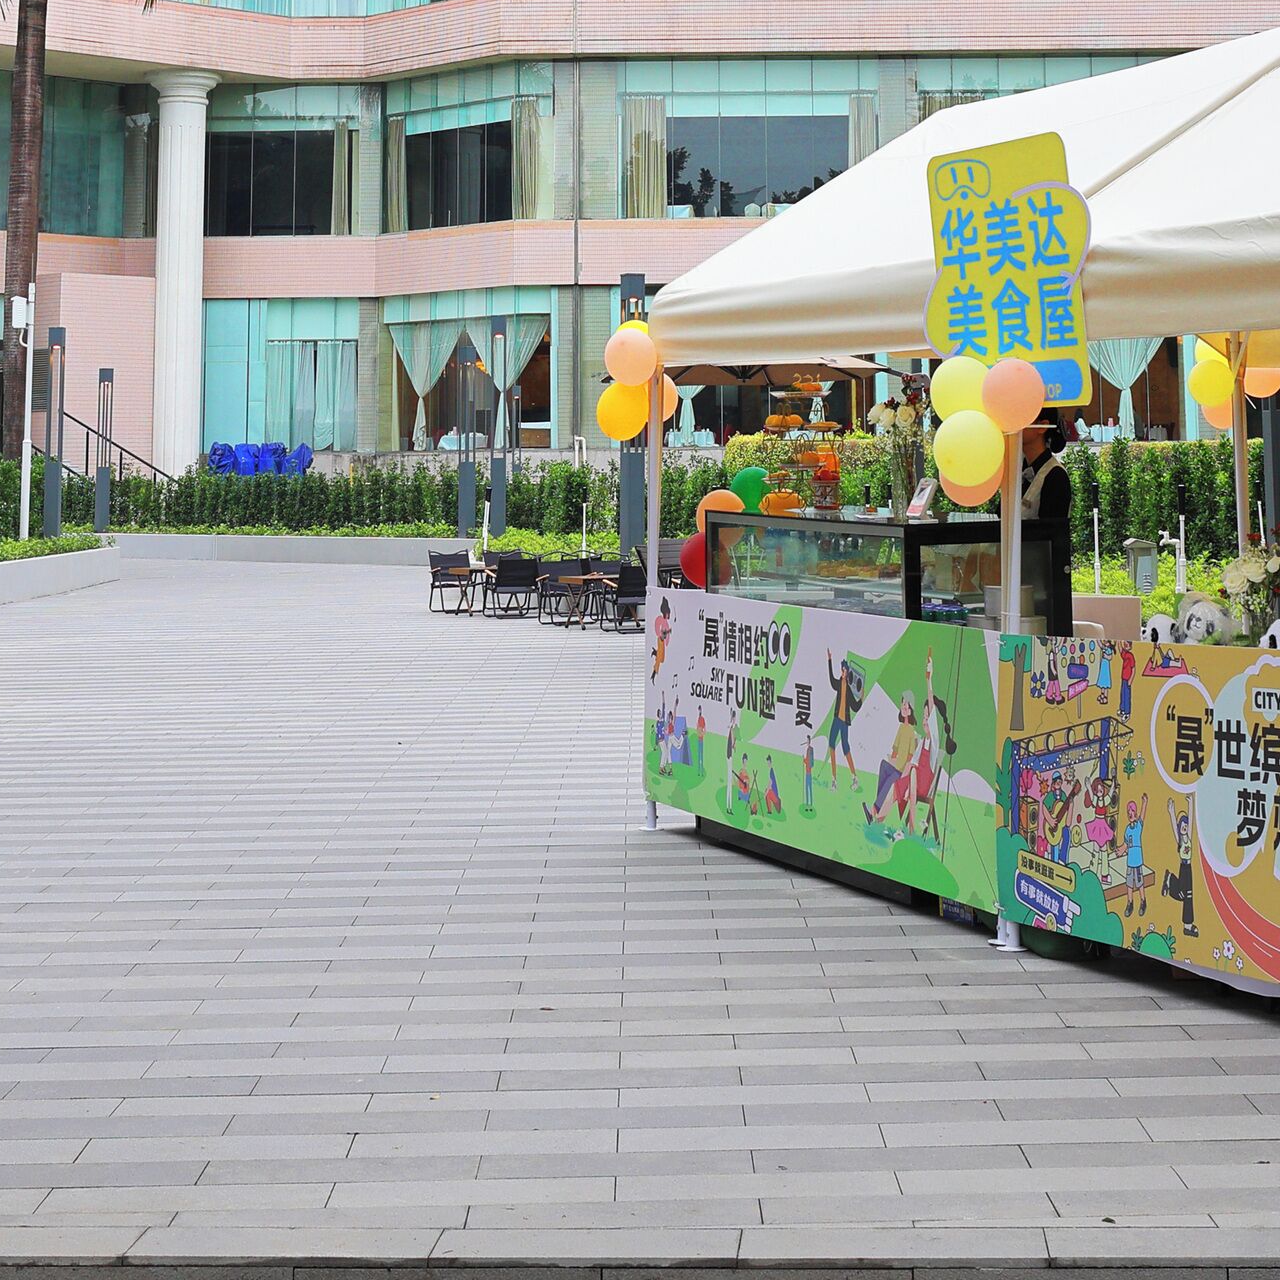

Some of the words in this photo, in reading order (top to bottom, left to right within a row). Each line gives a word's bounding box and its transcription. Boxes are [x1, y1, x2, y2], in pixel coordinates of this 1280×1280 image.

[940, 191, 1070, 280] 华美达
[946, 275, 1078, 357] 美食屋
[1046, 383, 1062, 399] OP
[710, 667, 726, 684] SKY
[690, 682, 723, 702] SQUARE
